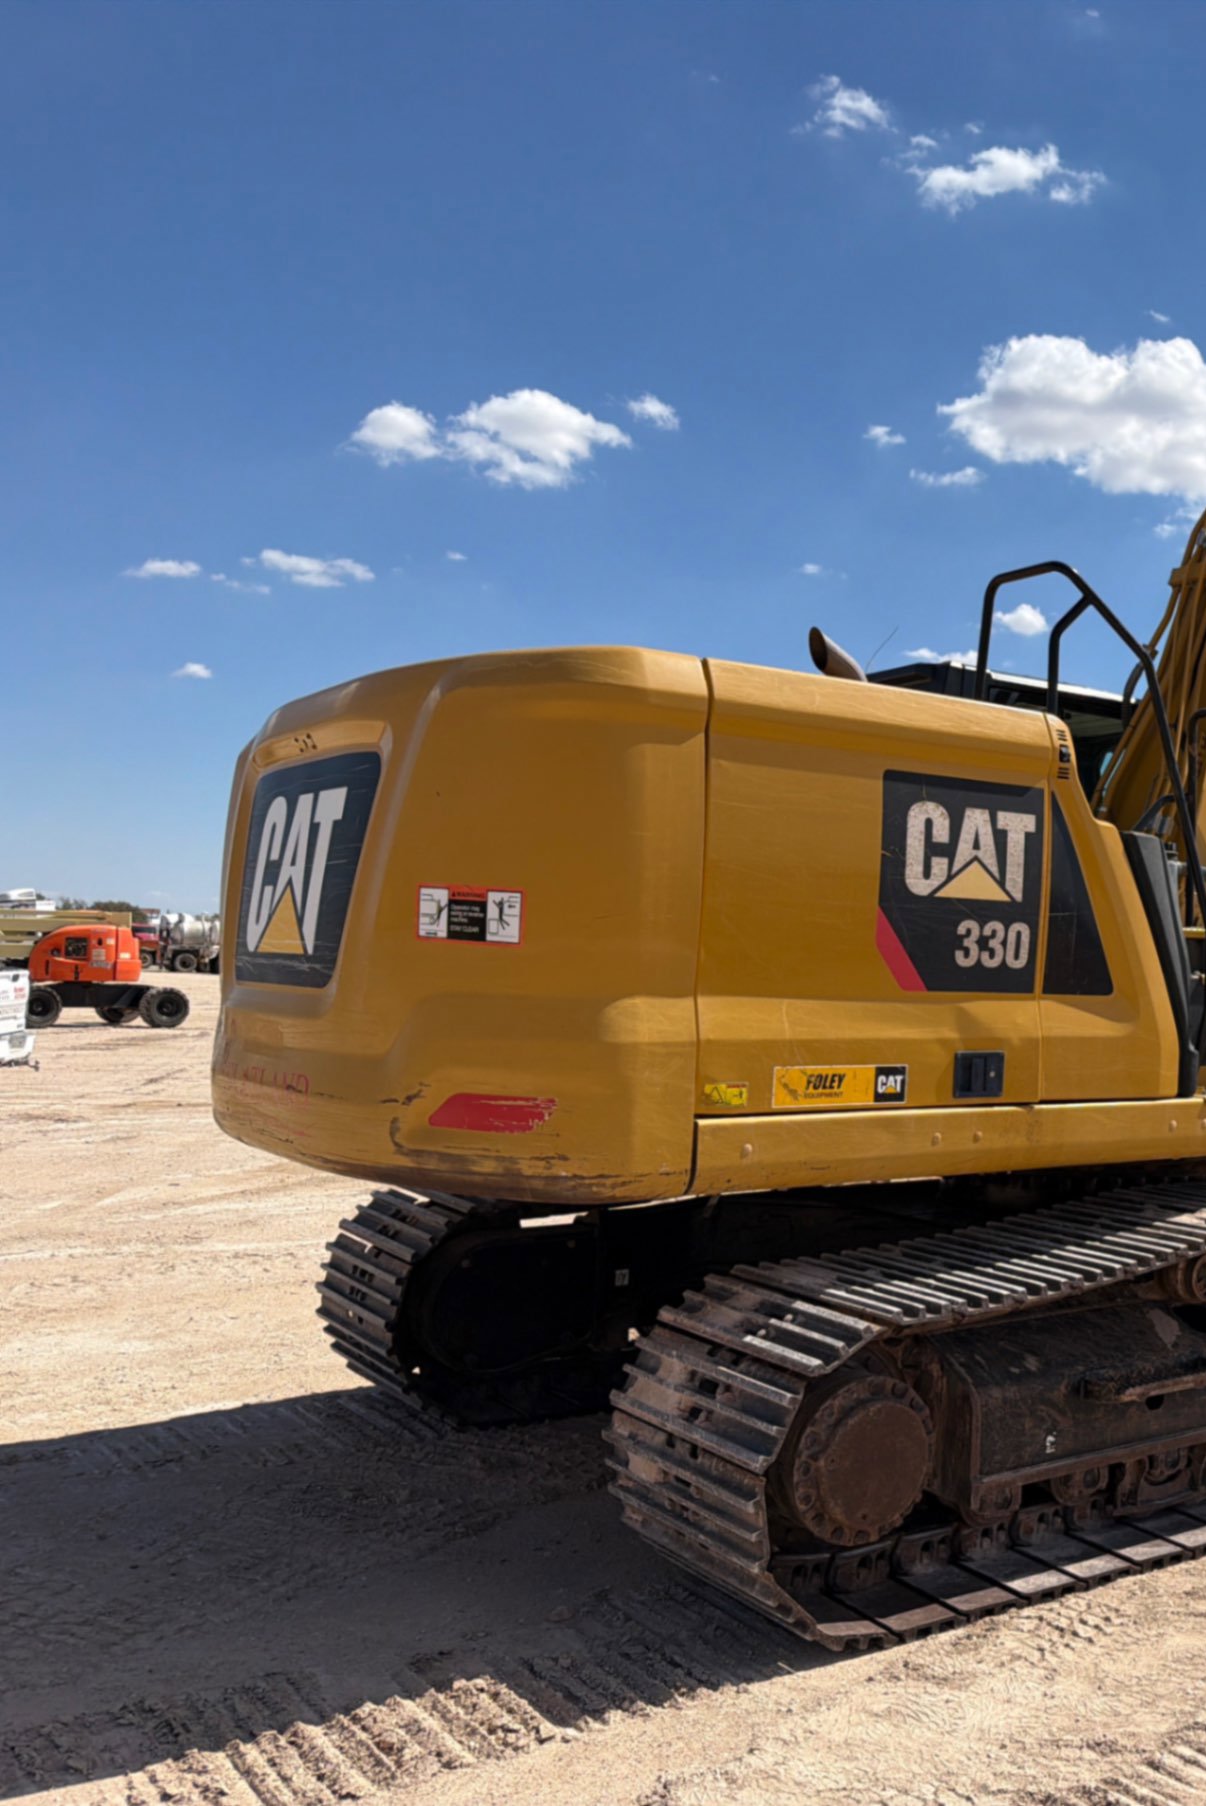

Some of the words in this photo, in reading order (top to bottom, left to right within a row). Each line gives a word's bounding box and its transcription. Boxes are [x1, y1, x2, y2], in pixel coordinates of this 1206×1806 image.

[246, 786, 348, 956] CAT
[904, 800, 1036, 902] CAT
[954, 919, 1031, 969] 330
[805, 1073, 846, 1090] FOLEY
[877, 1075, 903, 1094] CAT
